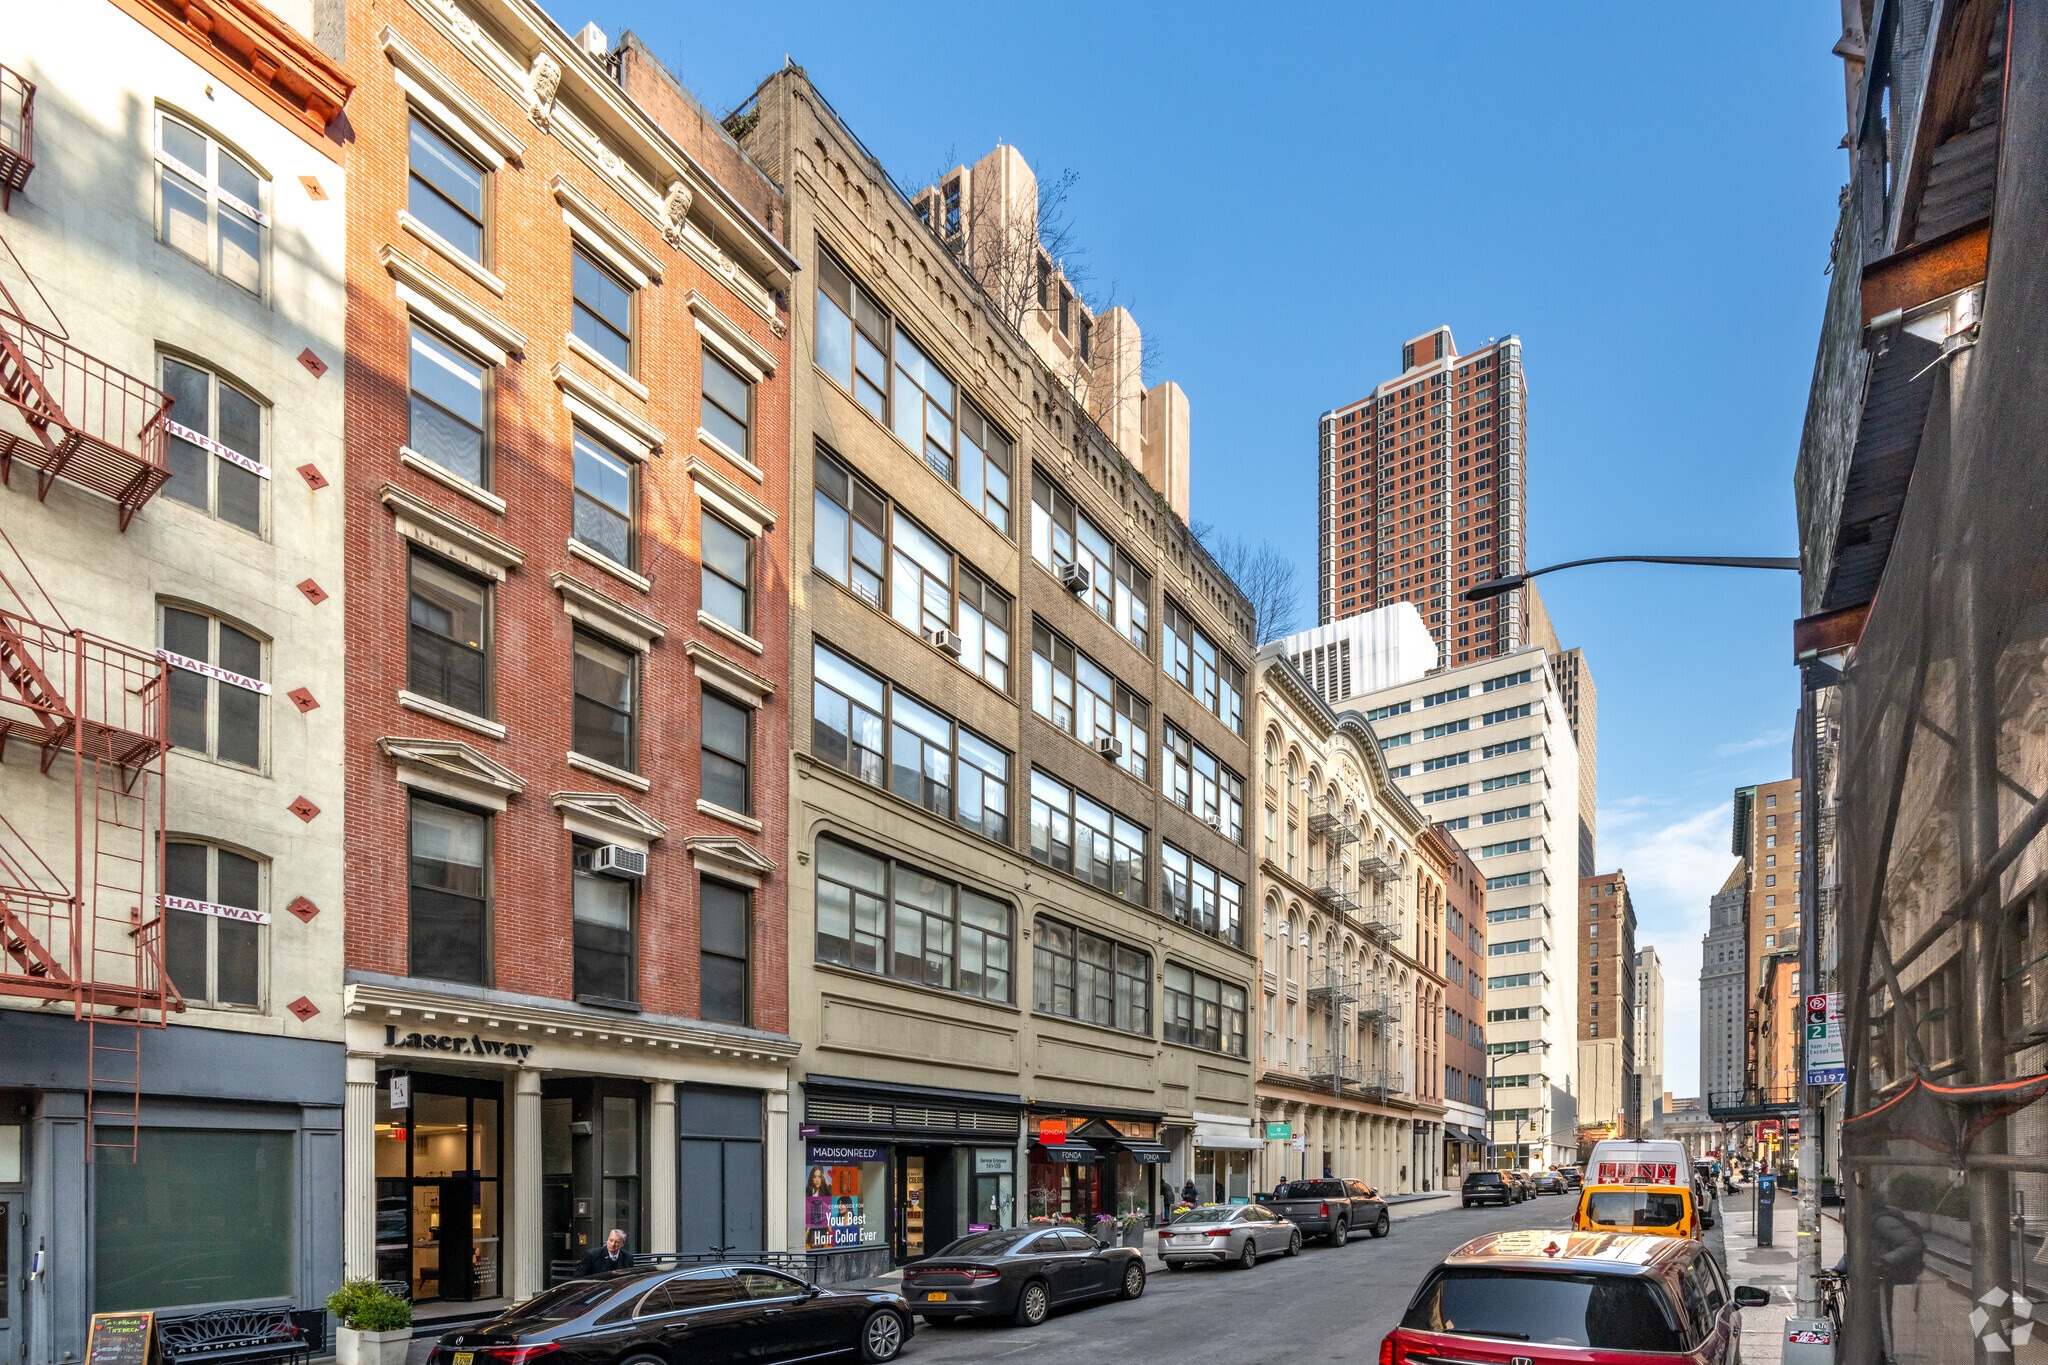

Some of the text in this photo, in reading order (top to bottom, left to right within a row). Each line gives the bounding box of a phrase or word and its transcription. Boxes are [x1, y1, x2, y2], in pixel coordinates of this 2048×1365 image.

[155, 649, 264, 691] SHAFTWAY
[155, 895, 264, 922] SHAFTWAY
[1812, 1025, 1822, 1038] 2
[384, 1024, 533, 1065] LaserAway
[1809, 1073, 1845, 1084] 10197
[813, 1147, 875, 1158] MADISONREED
[1062, 1151, 1082, 1159] FONDA
[1601, 1163, 1675, 1178] LENY
[825, 1211, 867, 1227] Your Best
[814, 1228, 877, 1245] Hair Color Ever
